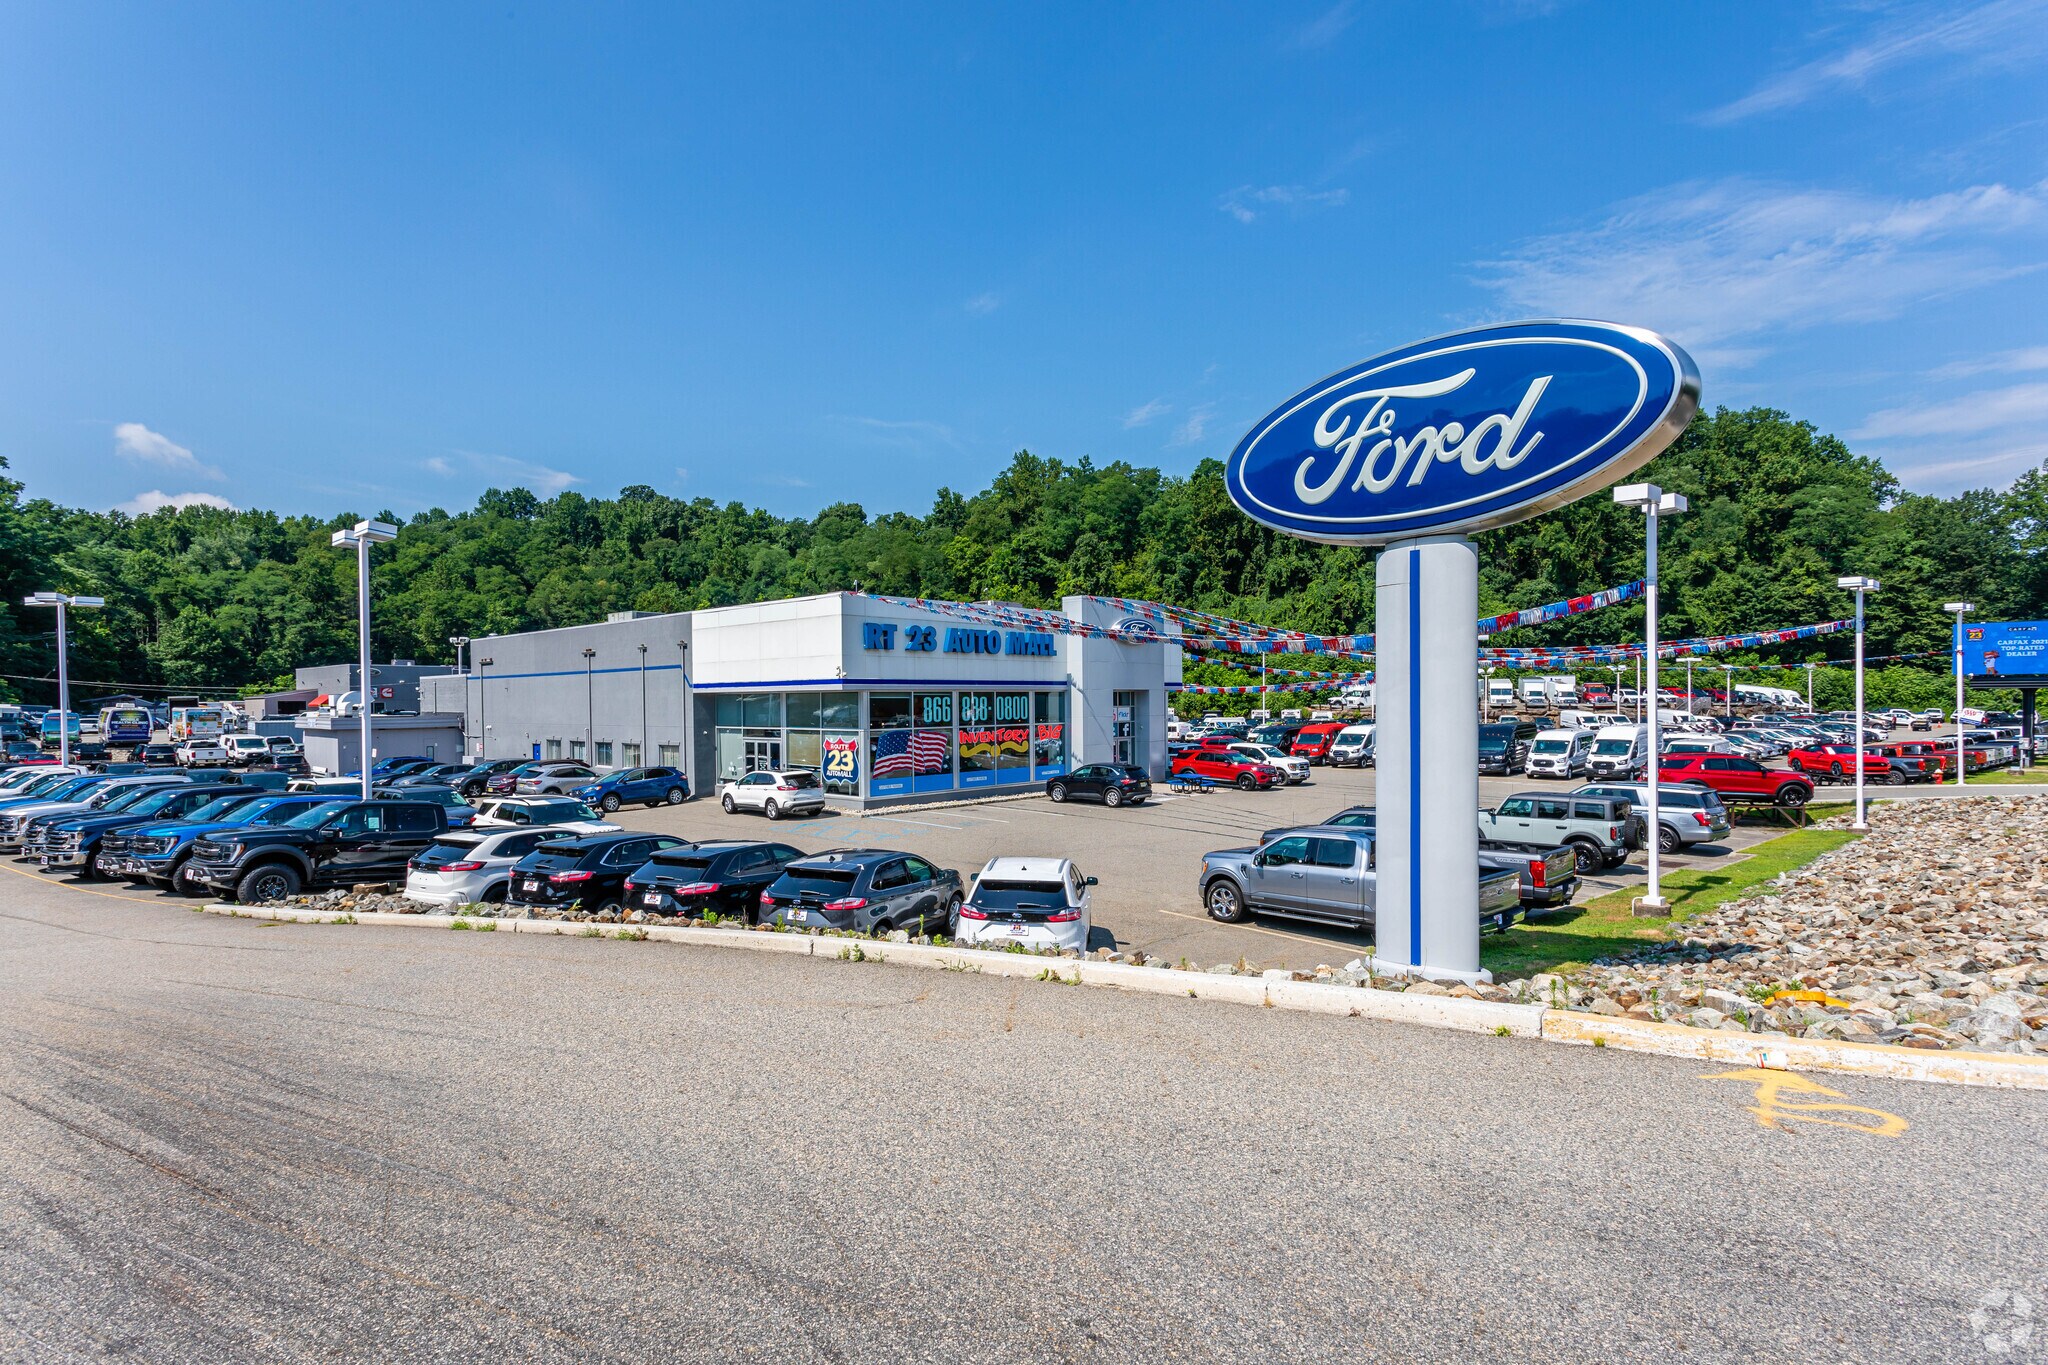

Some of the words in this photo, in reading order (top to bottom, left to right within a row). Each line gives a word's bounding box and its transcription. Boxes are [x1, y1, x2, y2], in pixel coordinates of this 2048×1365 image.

[1294, 368, 1553, 505] Ford
[863, 622, 897, 650] RT
[905, 624, 938, 652] 23
[943, 627, 1001, 654] AUTO
[1005, 631, 1057, 657] MALL
[923, 696, 951, 723] 866
[959, 728, 1029, 744] INVENTORY
[1038, 724, 1063, 741] BIG
[827, 749, 854, 772] 23
[826, 770, 854, 778] AUTOMALL
